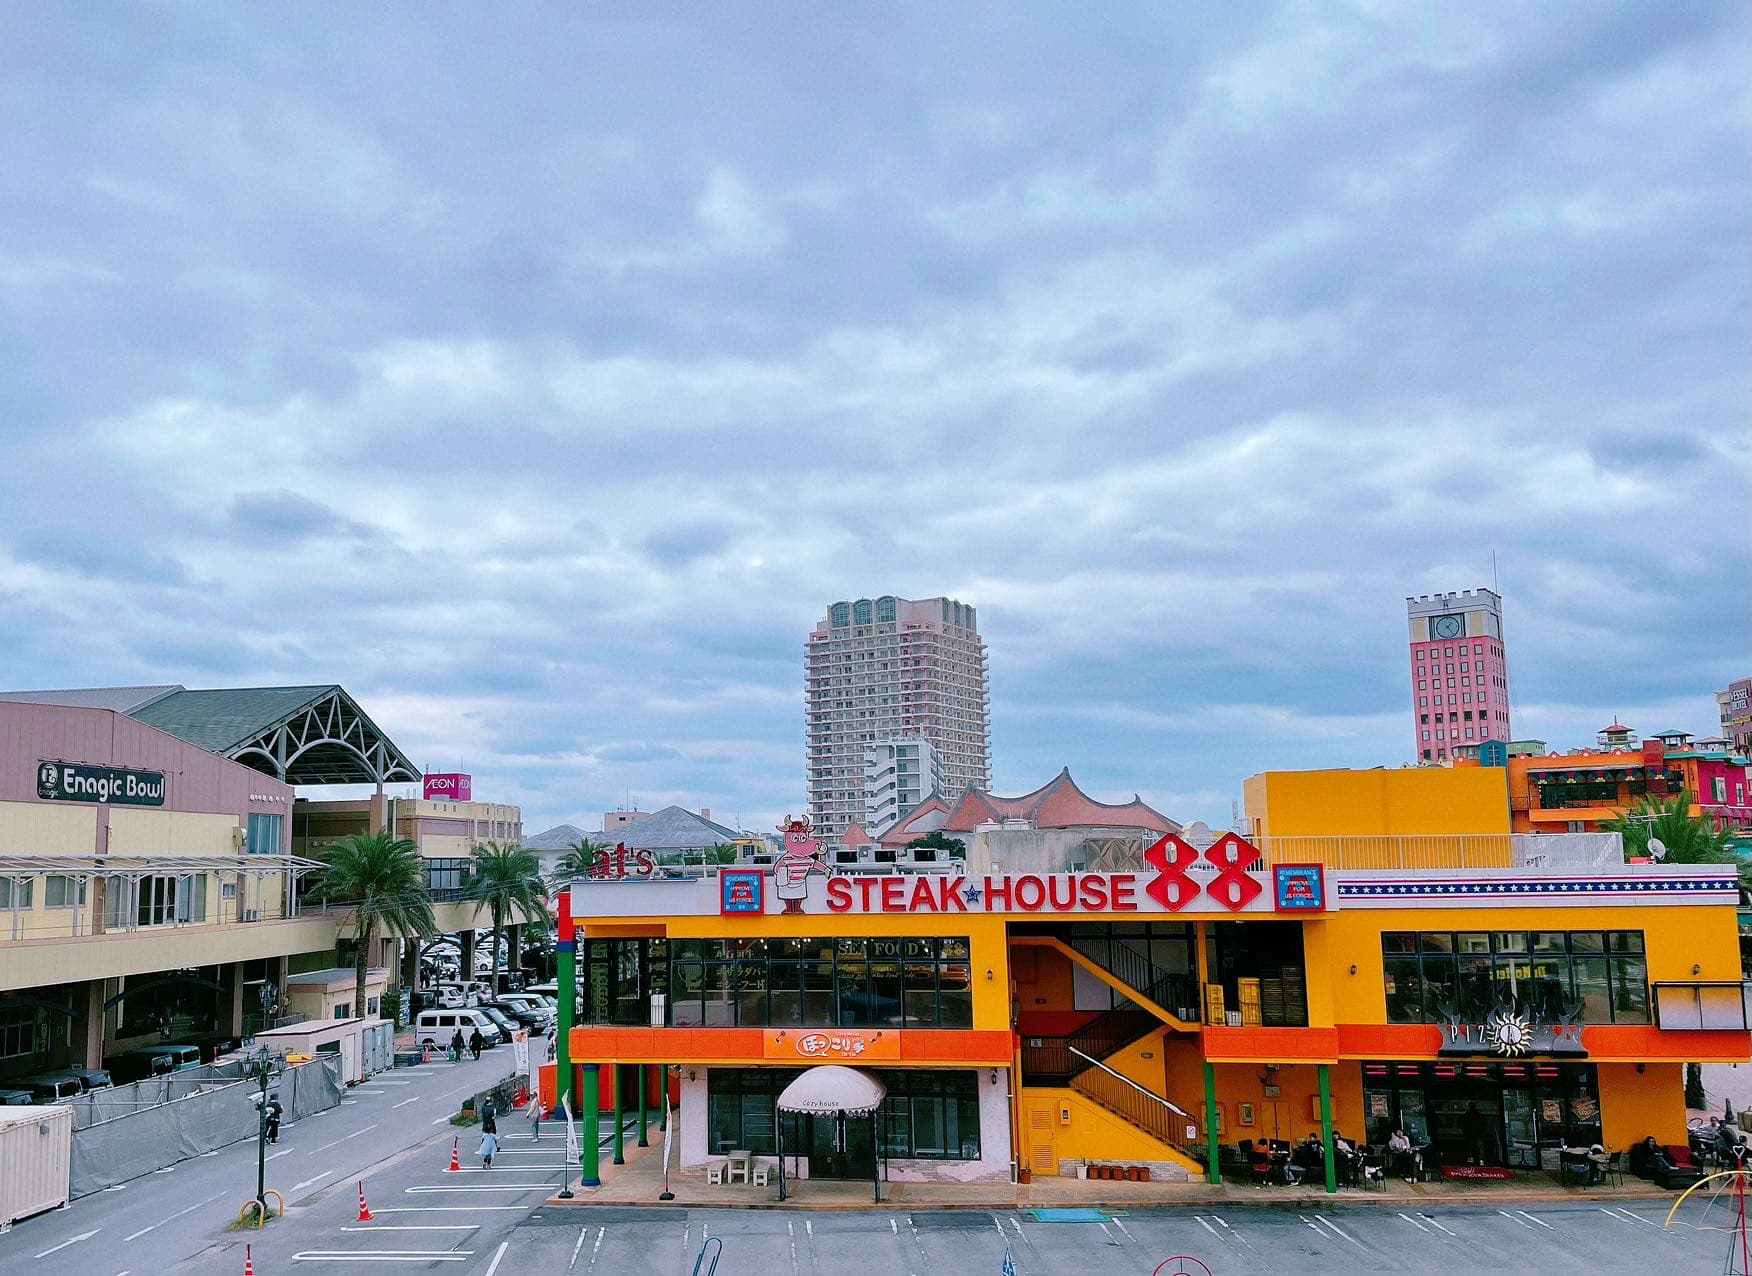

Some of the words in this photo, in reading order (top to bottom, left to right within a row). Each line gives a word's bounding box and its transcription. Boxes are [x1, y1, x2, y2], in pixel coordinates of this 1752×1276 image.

[63, 768, 122, 802] Enagic
[126, 774, 164, 798] Bowl
[826, 875, 967, 912] STEAK
[984, 874, 1137, 911] HOUSE
[1144, 832, 1263, 912] 88
[838, 942, 867, 956] SEA
[1451, 1024, 1515, 1044] PIZZA
